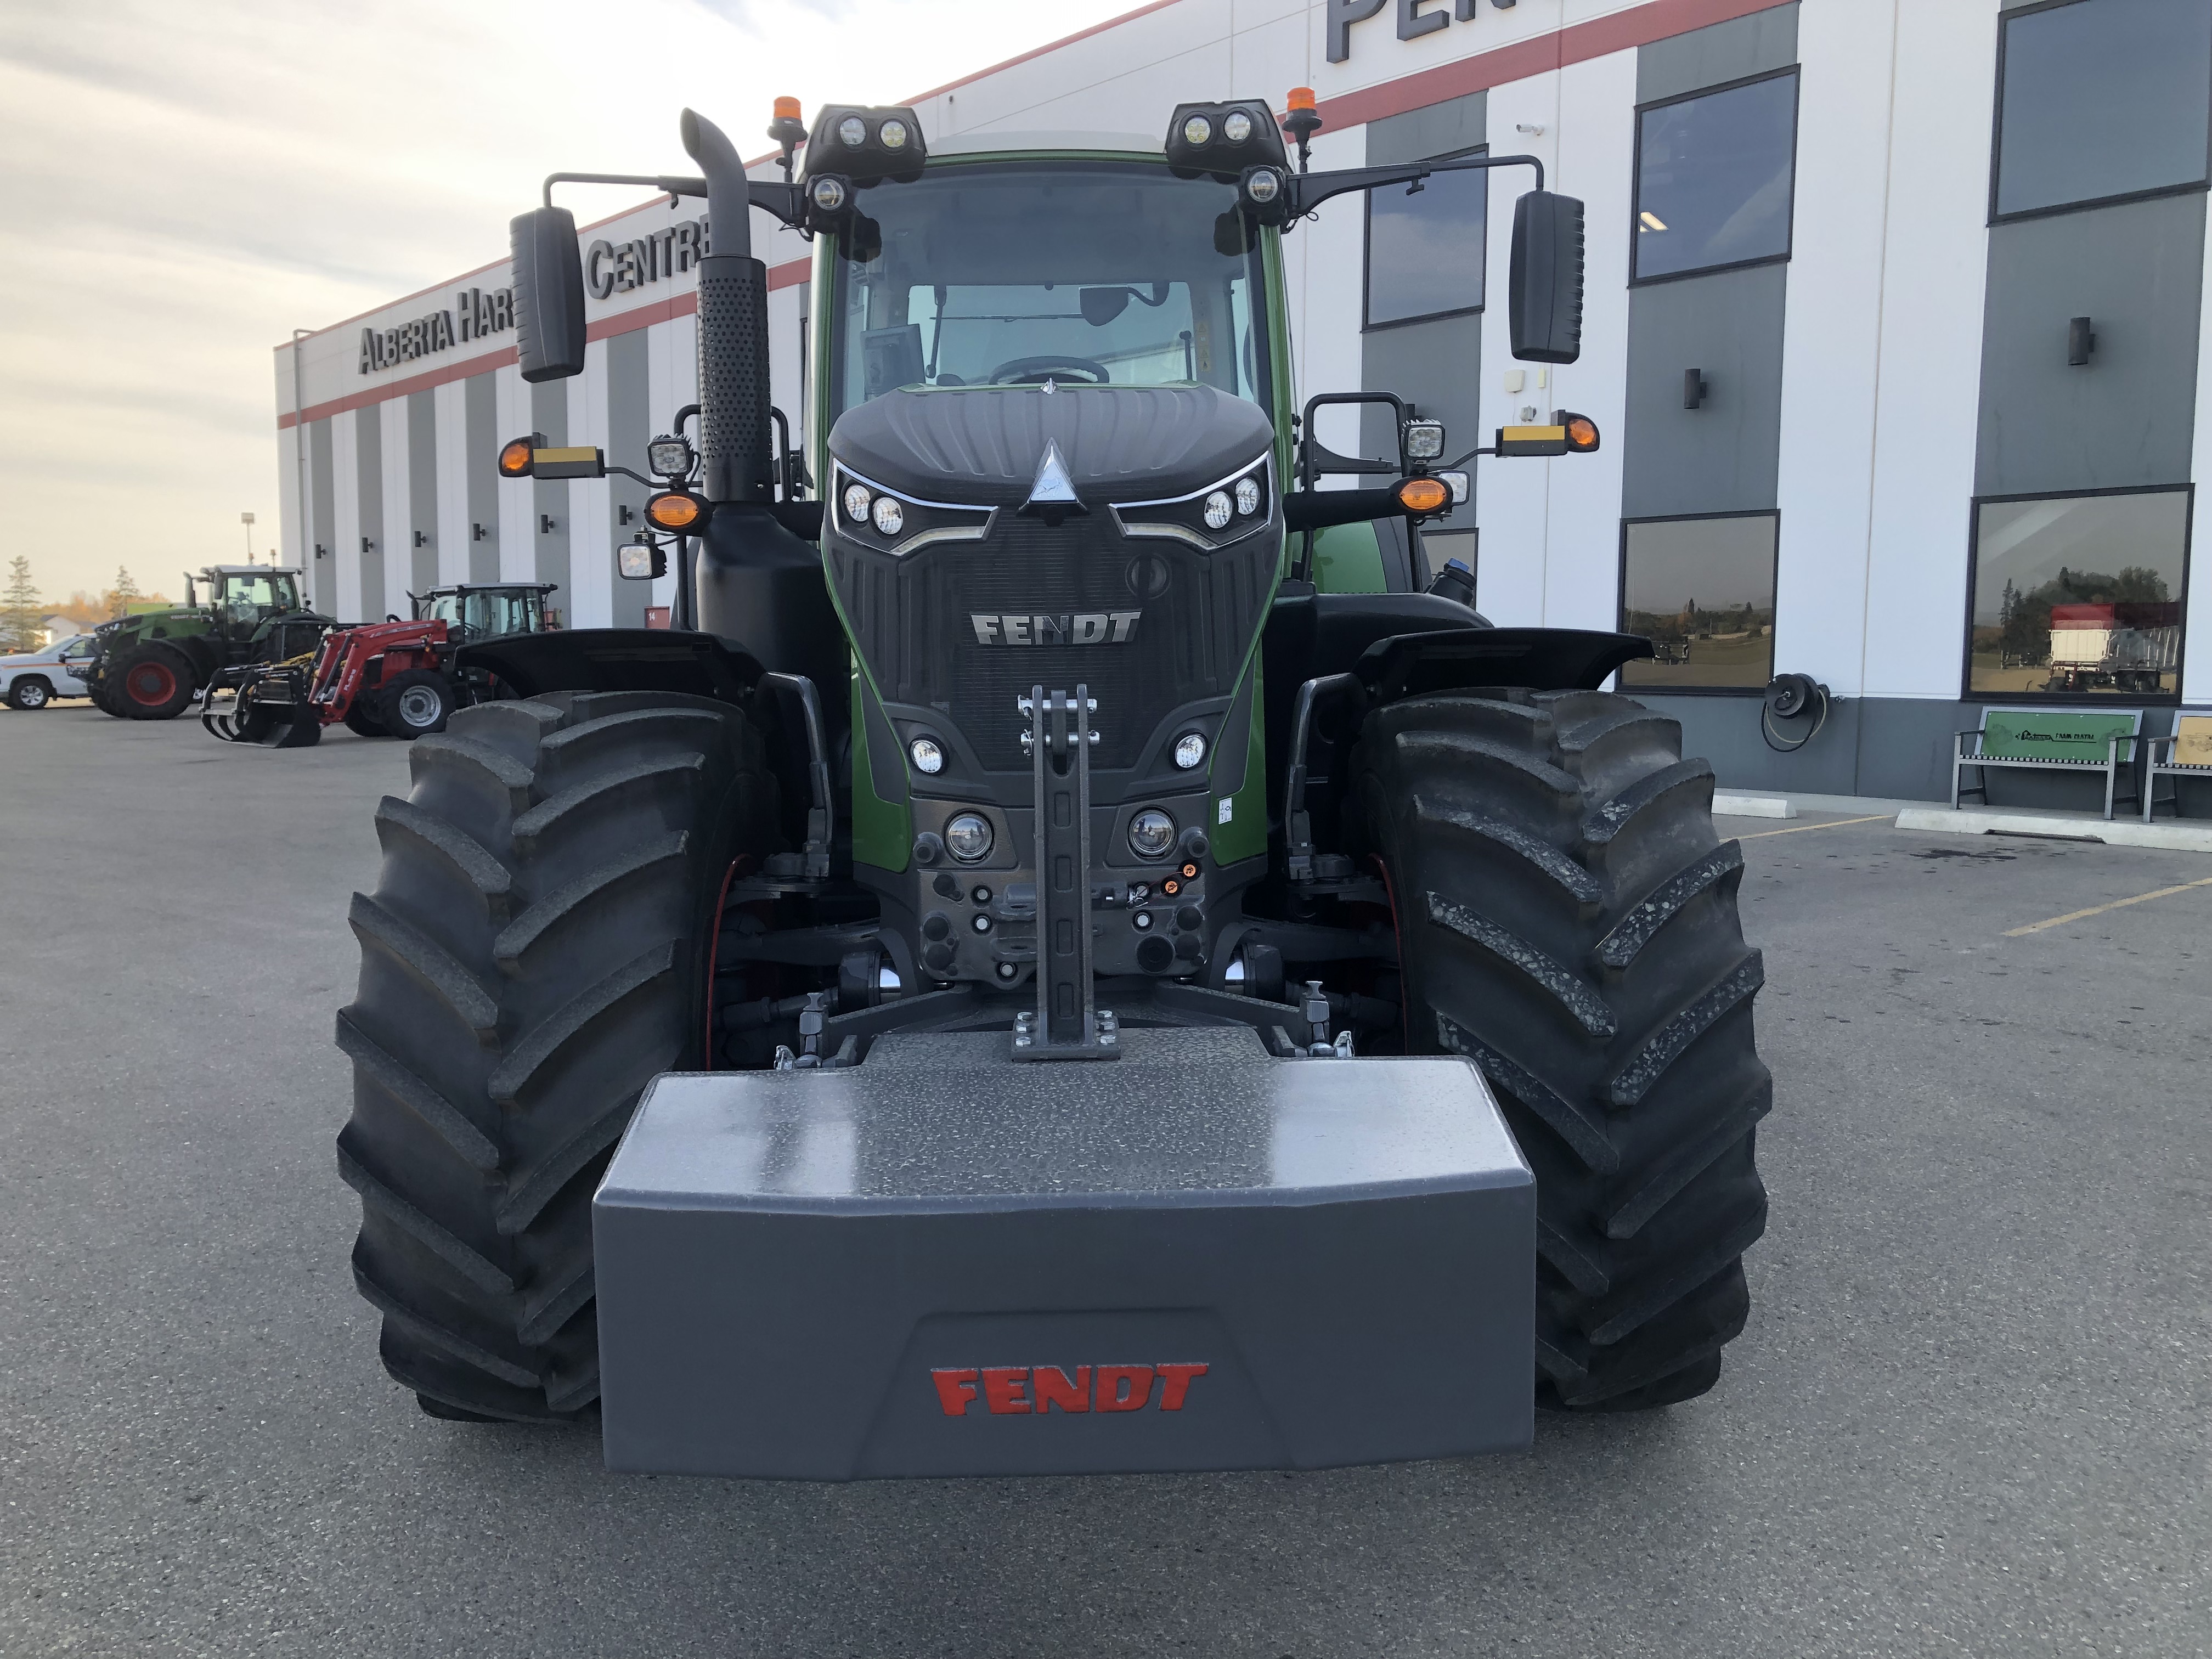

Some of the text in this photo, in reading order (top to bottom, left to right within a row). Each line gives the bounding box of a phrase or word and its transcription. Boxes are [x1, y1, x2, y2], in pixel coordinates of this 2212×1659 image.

[1326, 0, 1516, 64] PE
[357, 309, 454, 374] ALBERTA
[457, 287, 515, 342] HAR
[648, 612, 656, 621] 14
[970, 611, 1142, 645] FENDT
[930, 1362, 1209, 1416] FENDT
